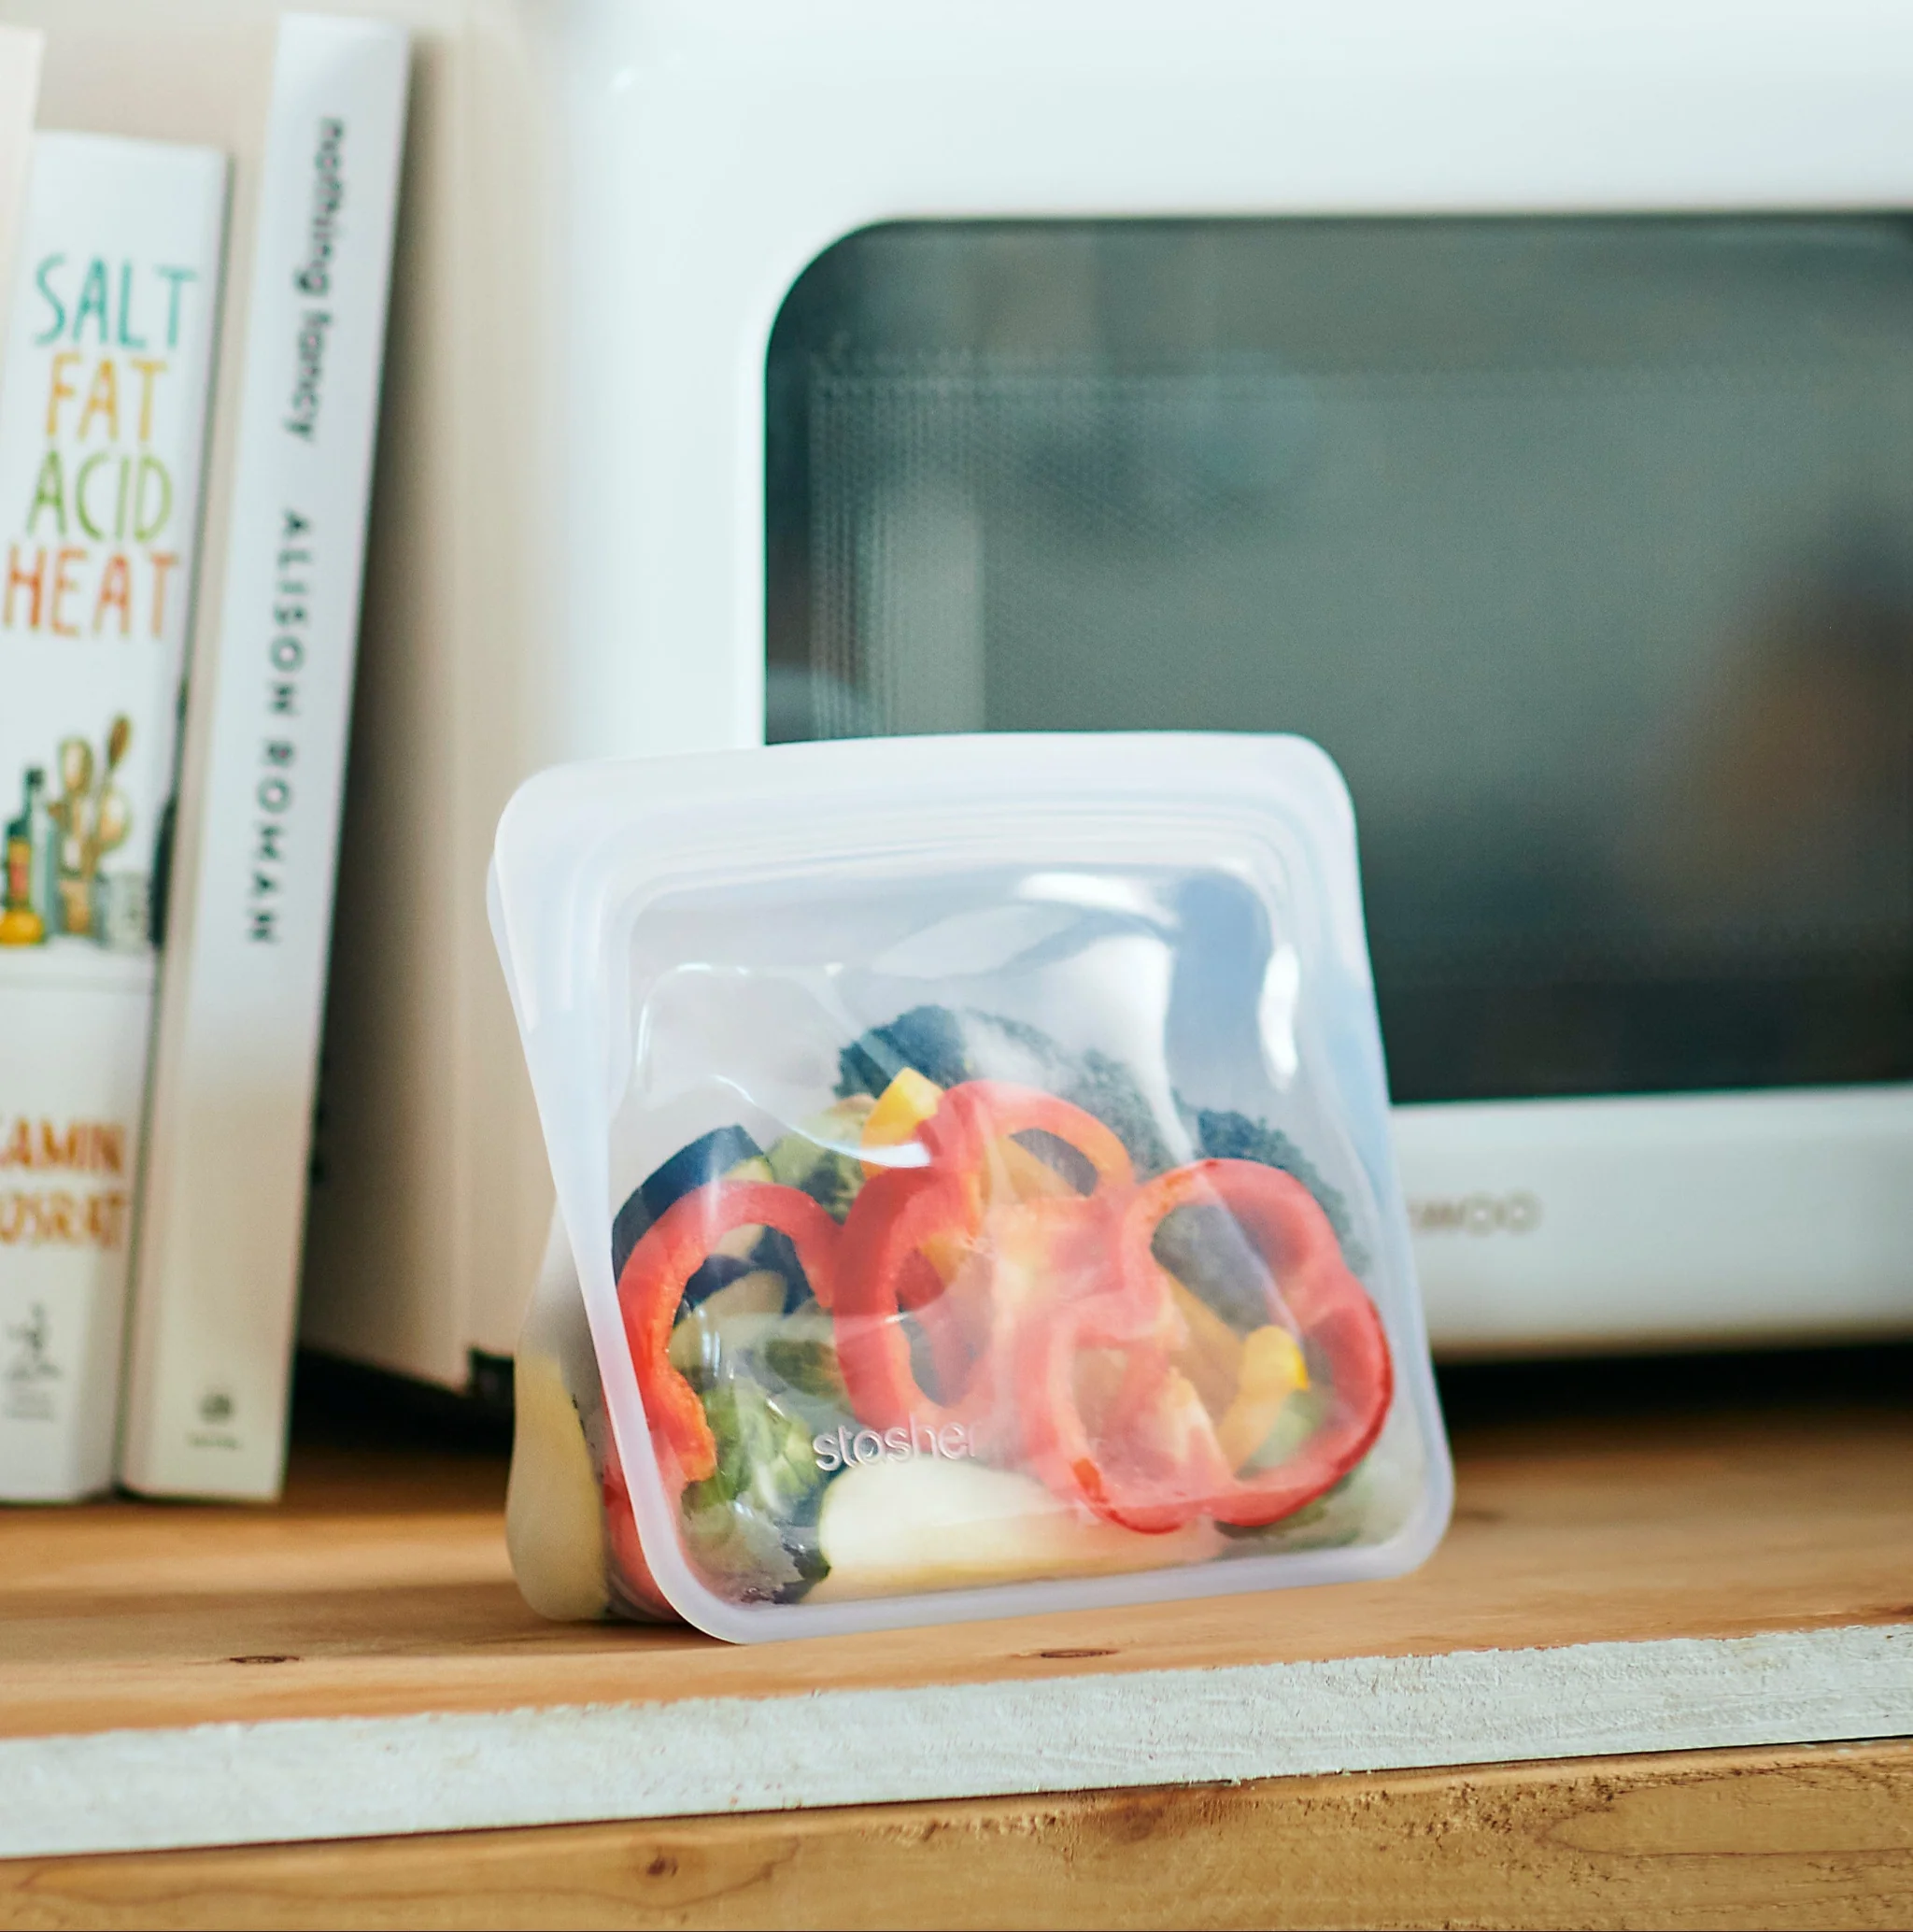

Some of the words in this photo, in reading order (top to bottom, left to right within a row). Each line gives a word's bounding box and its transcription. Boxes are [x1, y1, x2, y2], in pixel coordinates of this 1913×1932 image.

[293, 117, 346, 297] nothing
[34, 252, 197, 350] SALT
[45, 351, 168, 443] FAT
[283, 311, 333, 444] fancy
[25, 447, 173, 544] ACID
[2, 544, 180, 641] HEAT
[268, 508, 314, 717] ALISON
[248, 738, 295, 944] ROMAN
[813, 1413, 984, 1471] stasher
